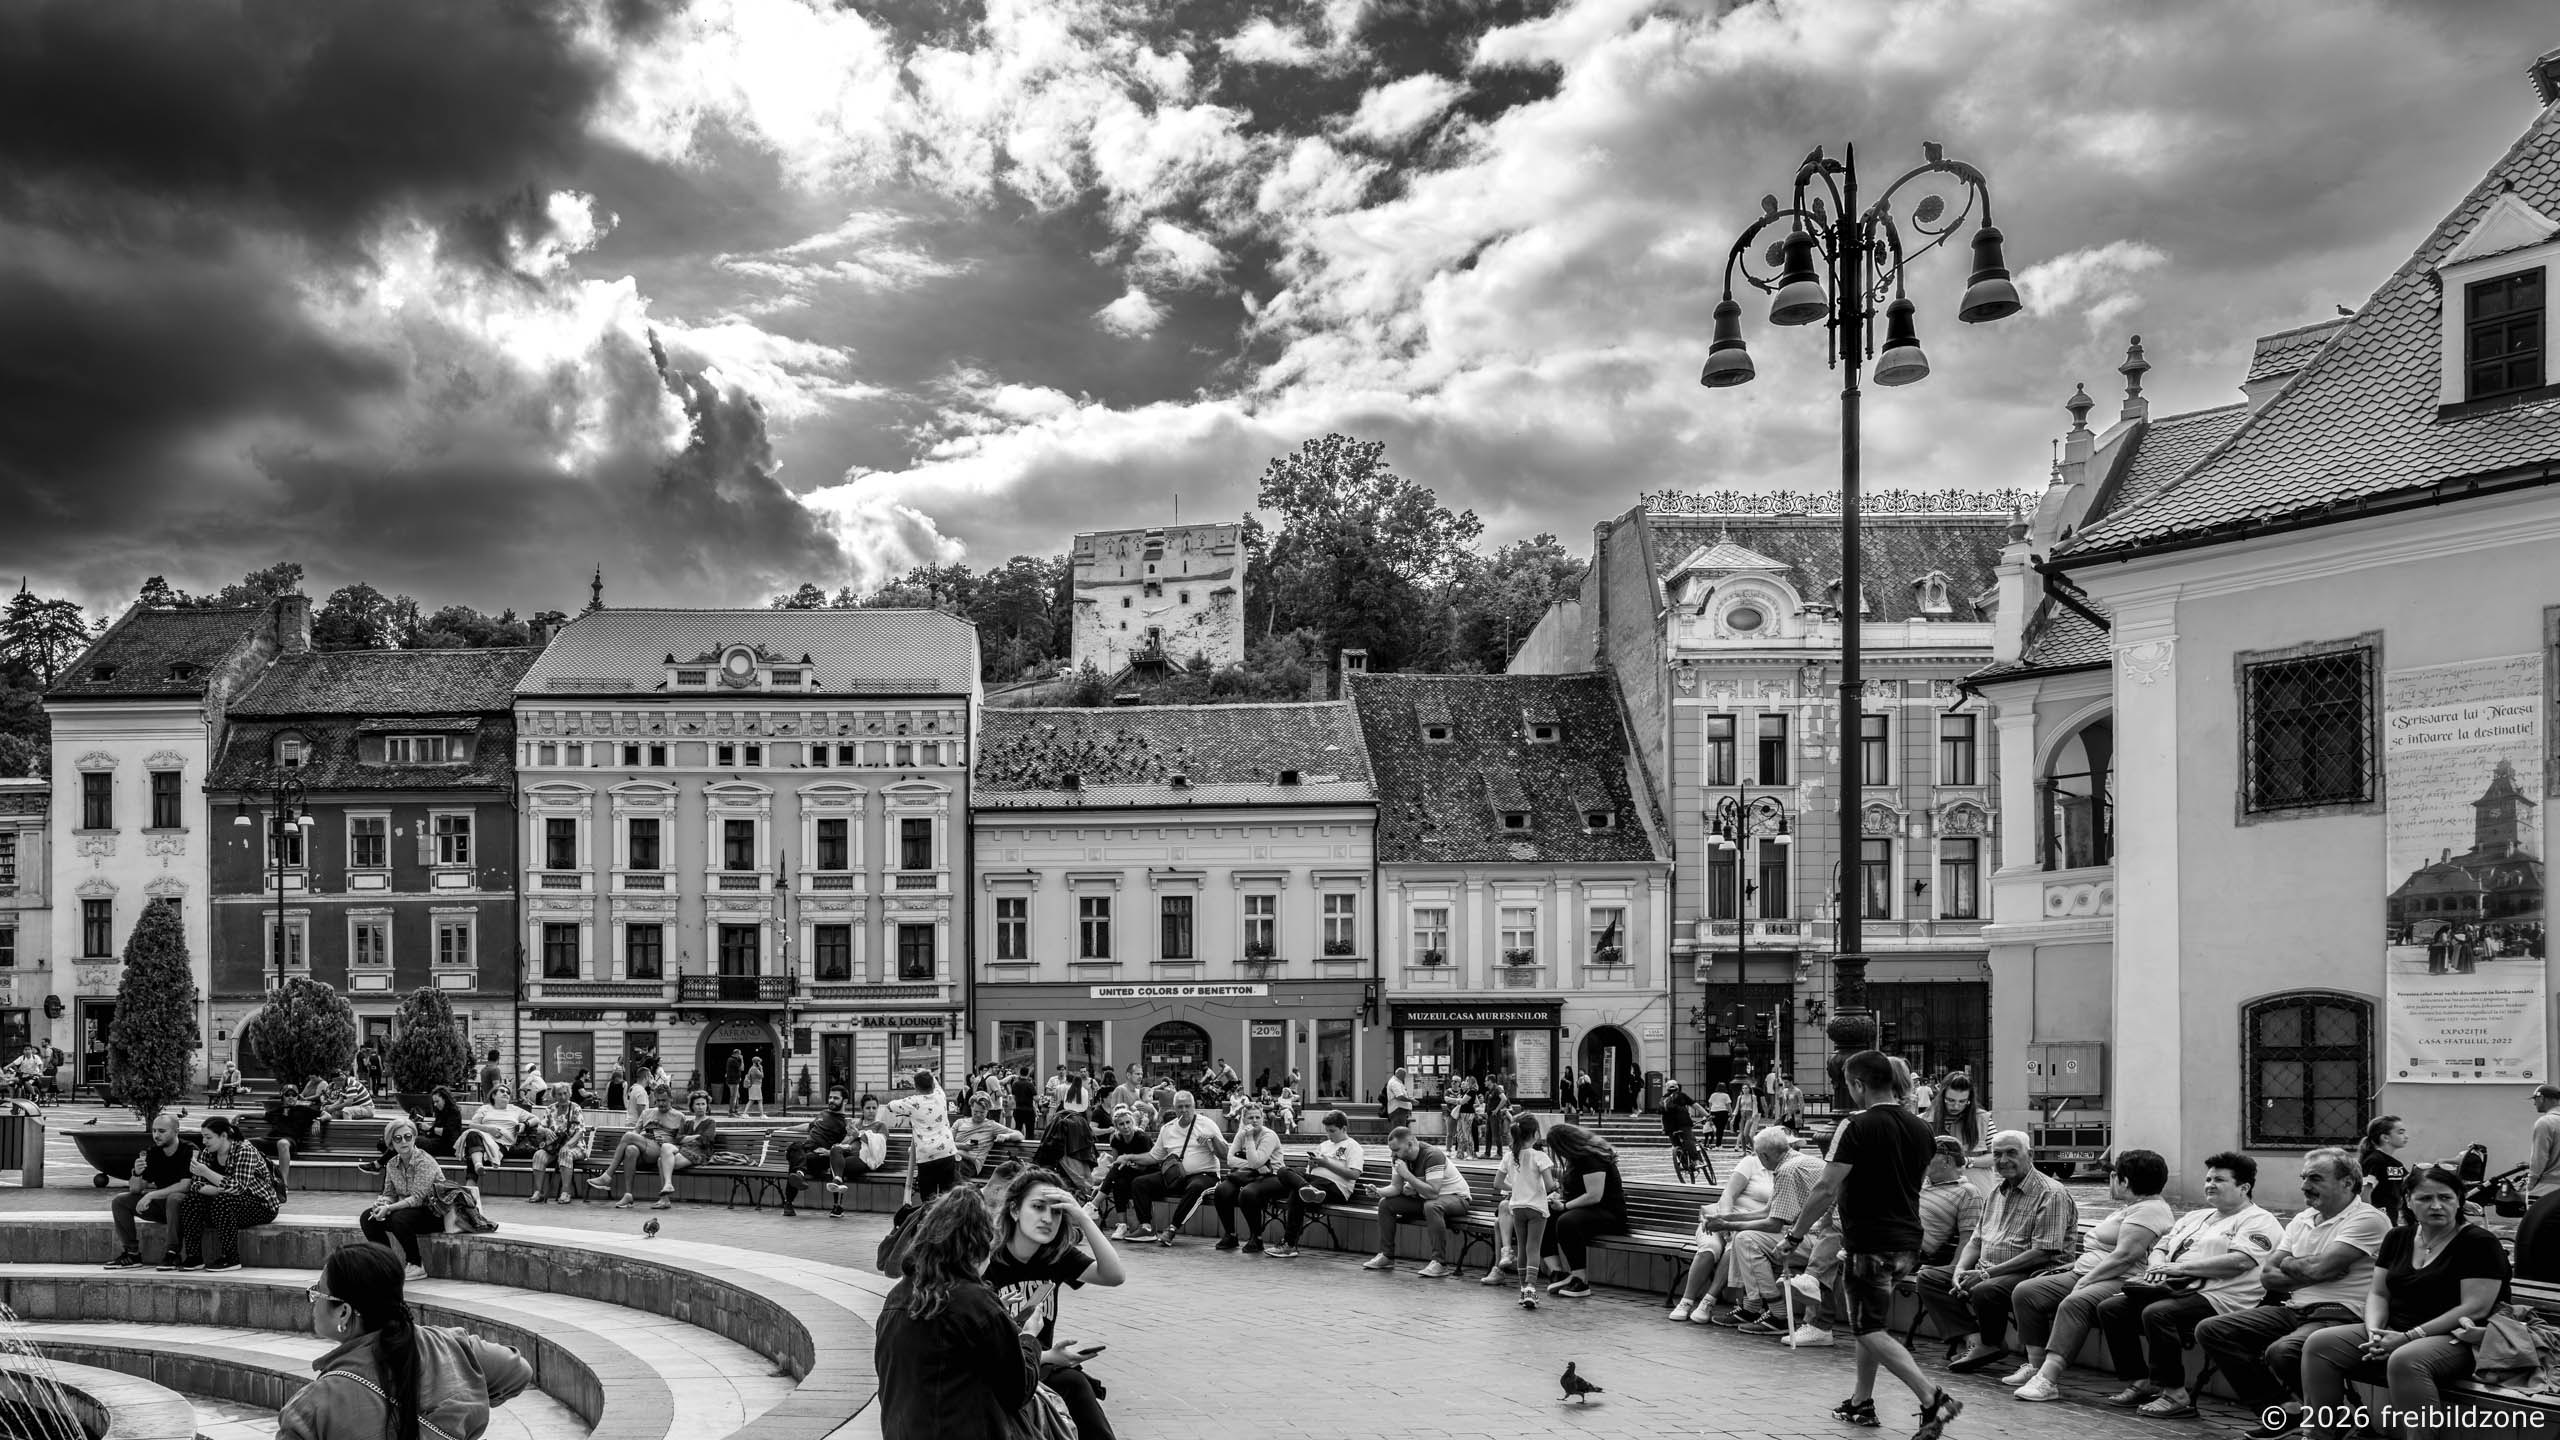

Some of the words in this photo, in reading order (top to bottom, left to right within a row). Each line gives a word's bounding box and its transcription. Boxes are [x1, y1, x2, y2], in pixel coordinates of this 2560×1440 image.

[2392, 711, 2459, 729] Scrisoarea
[2464, 708, 2478, 720] lui
[2392, 737, 2403, 746] se
[2458, 728, 2469, 740] la
[1098, 987, 1134, 996] UNITED
[1137, 987, 1179, 996] COLORS
[1182, 986, 1195, 995] OF
[1197, 985, 1253, 995] BENETTON
[863, 1017, 886, 1027] BAR
[887, 1017, 897, 1027] &
[899, 1016, 943, 1026] LOUNGE
[1407, 1012, 1449, 1021] MUZEUL
[1449, 1012, 1475, 1021] CASA
[1253, 1026, 1281, 1036] -20%
